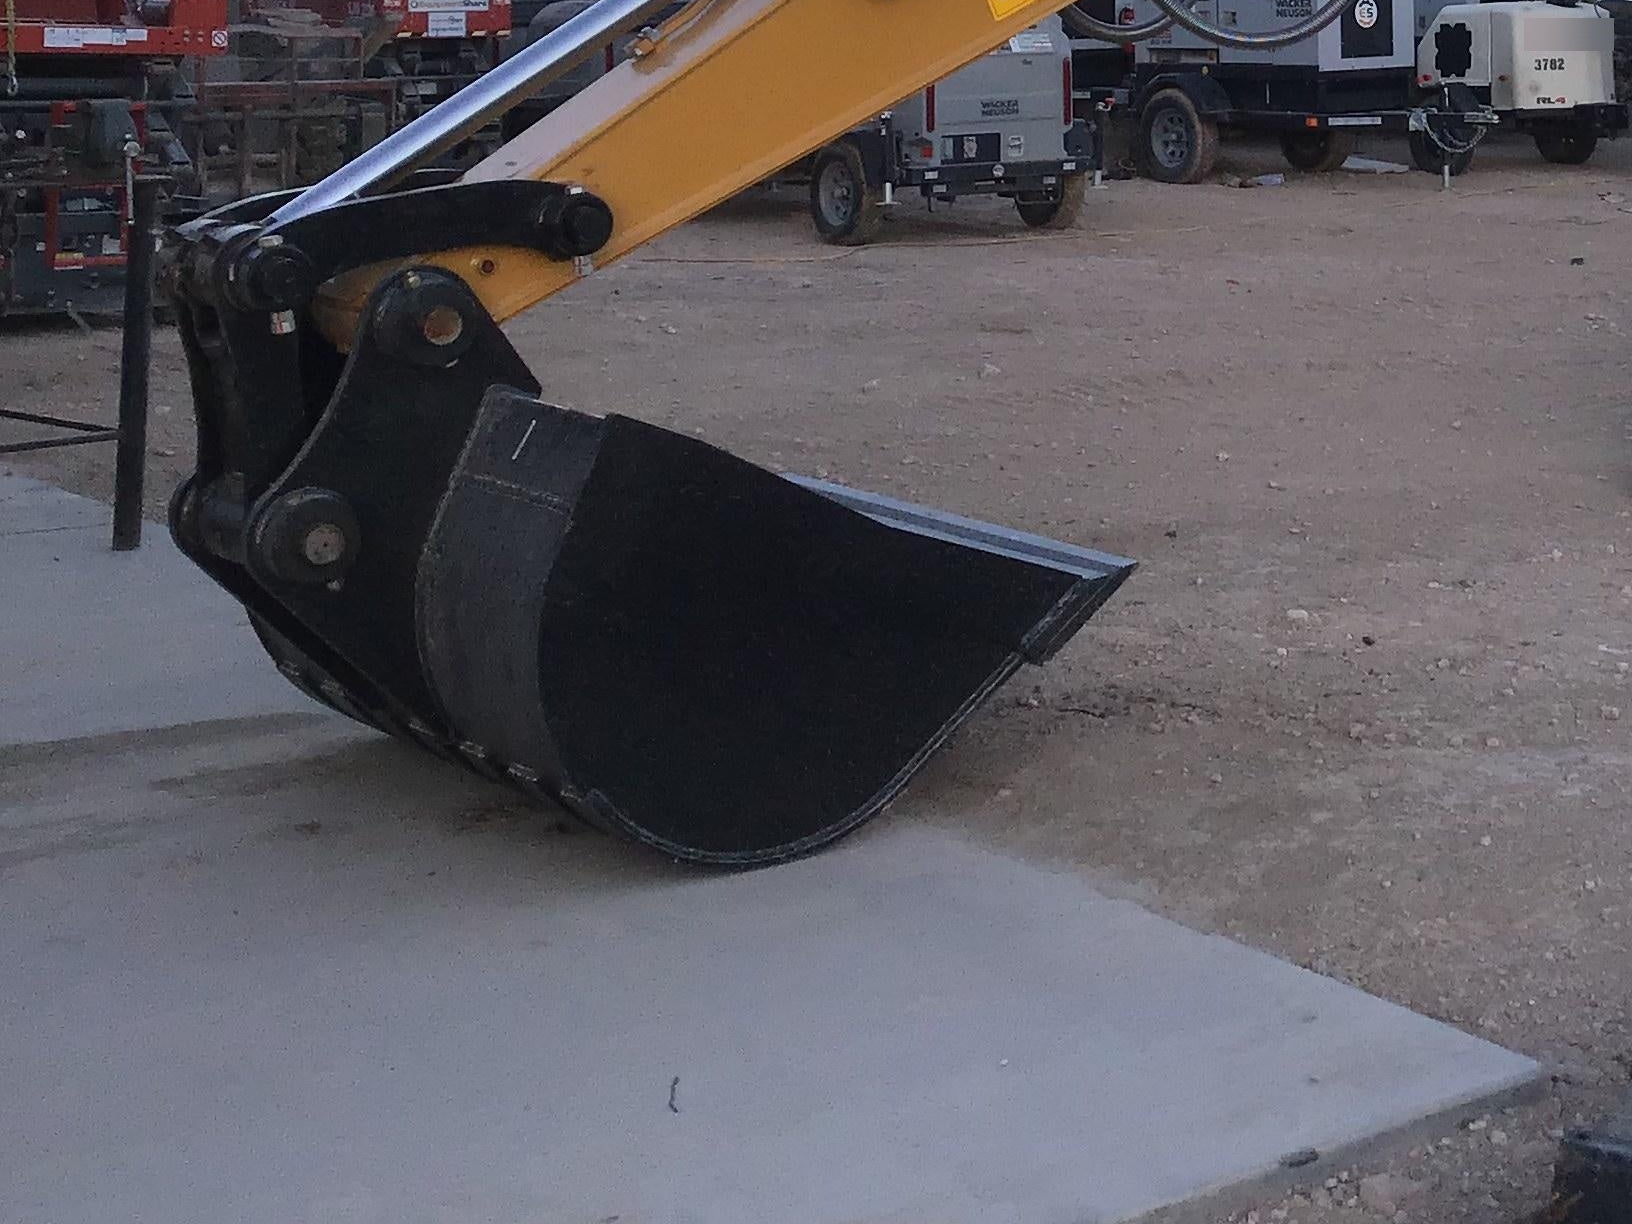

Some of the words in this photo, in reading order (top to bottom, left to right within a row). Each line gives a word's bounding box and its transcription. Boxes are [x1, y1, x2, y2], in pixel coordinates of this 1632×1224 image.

[1275, 7, 1312, 18] NEUSON
[1534, 58, 1565, 71] 3782
[980, 99, 1019, 109] WACKER
[981, 108, 1020, 117] NEUSON
